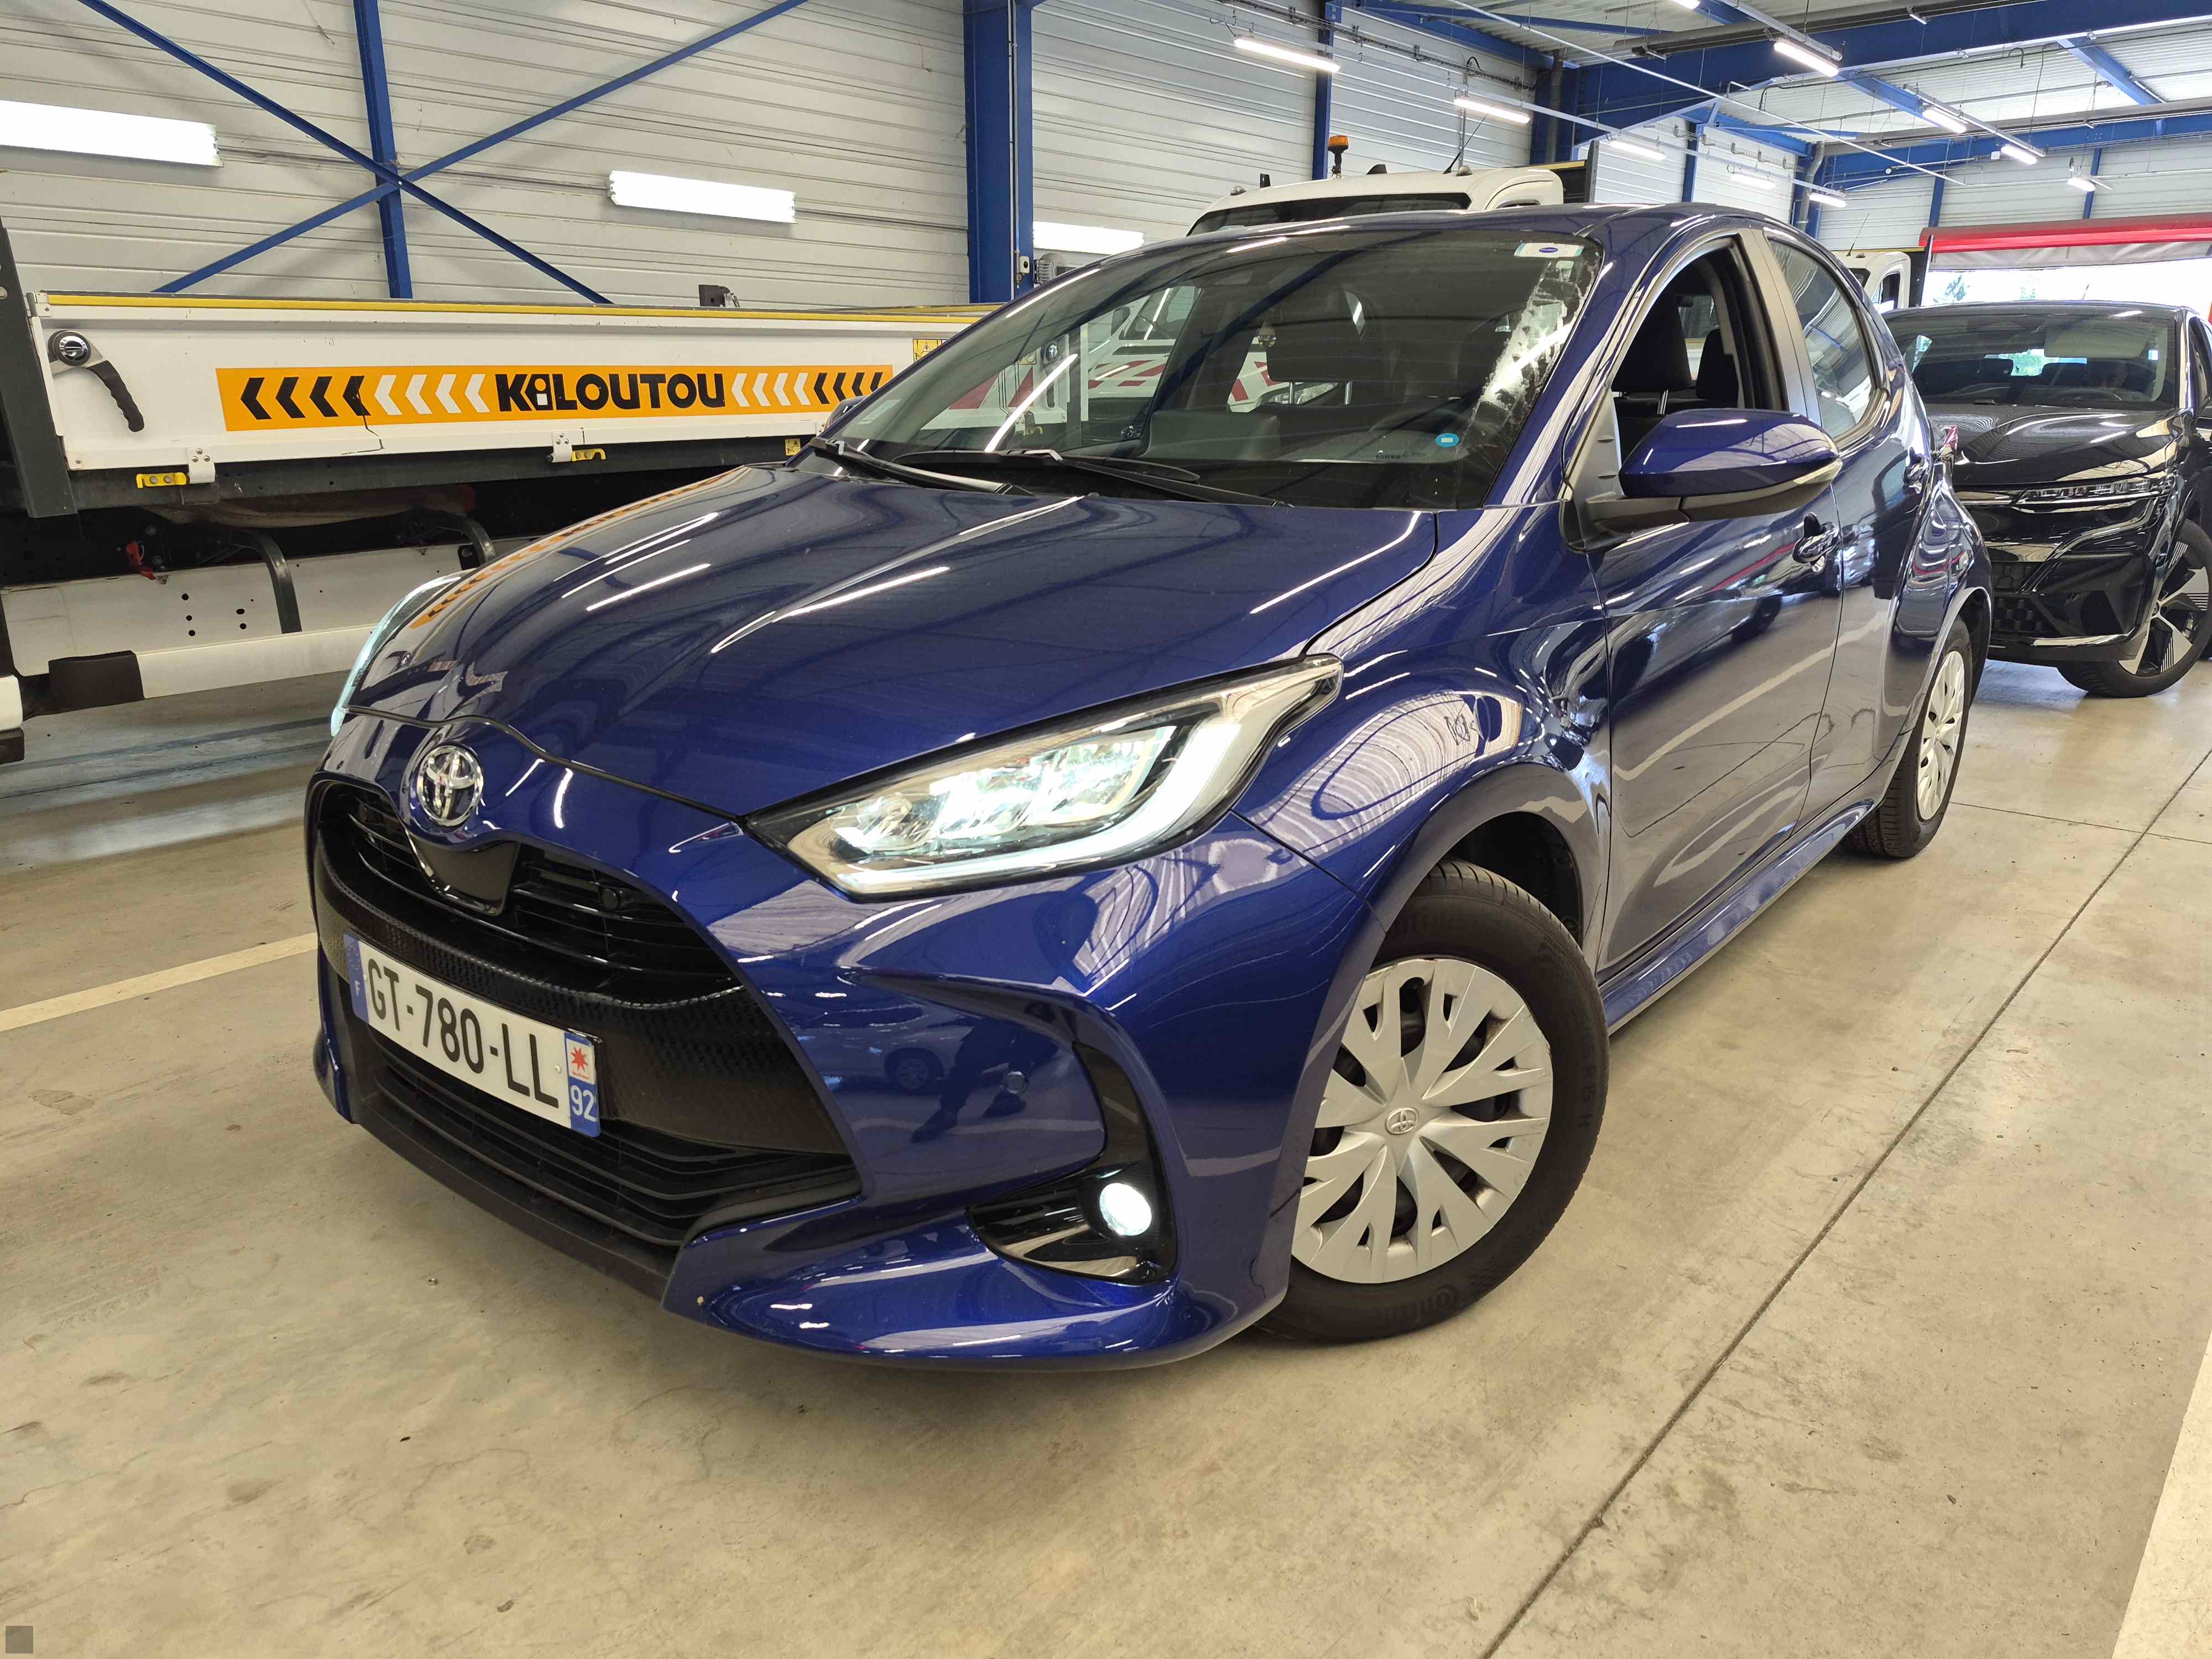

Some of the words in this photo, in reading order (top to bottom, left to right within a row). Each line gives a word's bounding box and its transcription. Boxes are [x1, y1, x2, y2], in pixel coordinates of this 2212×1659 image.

[494, 373, 726, 412] KILOUTOU
[354, 979, 361, 996] F
[368, 958, 559, 1109] GT-780-LL
[571, 1084, 596, 1122] 92
